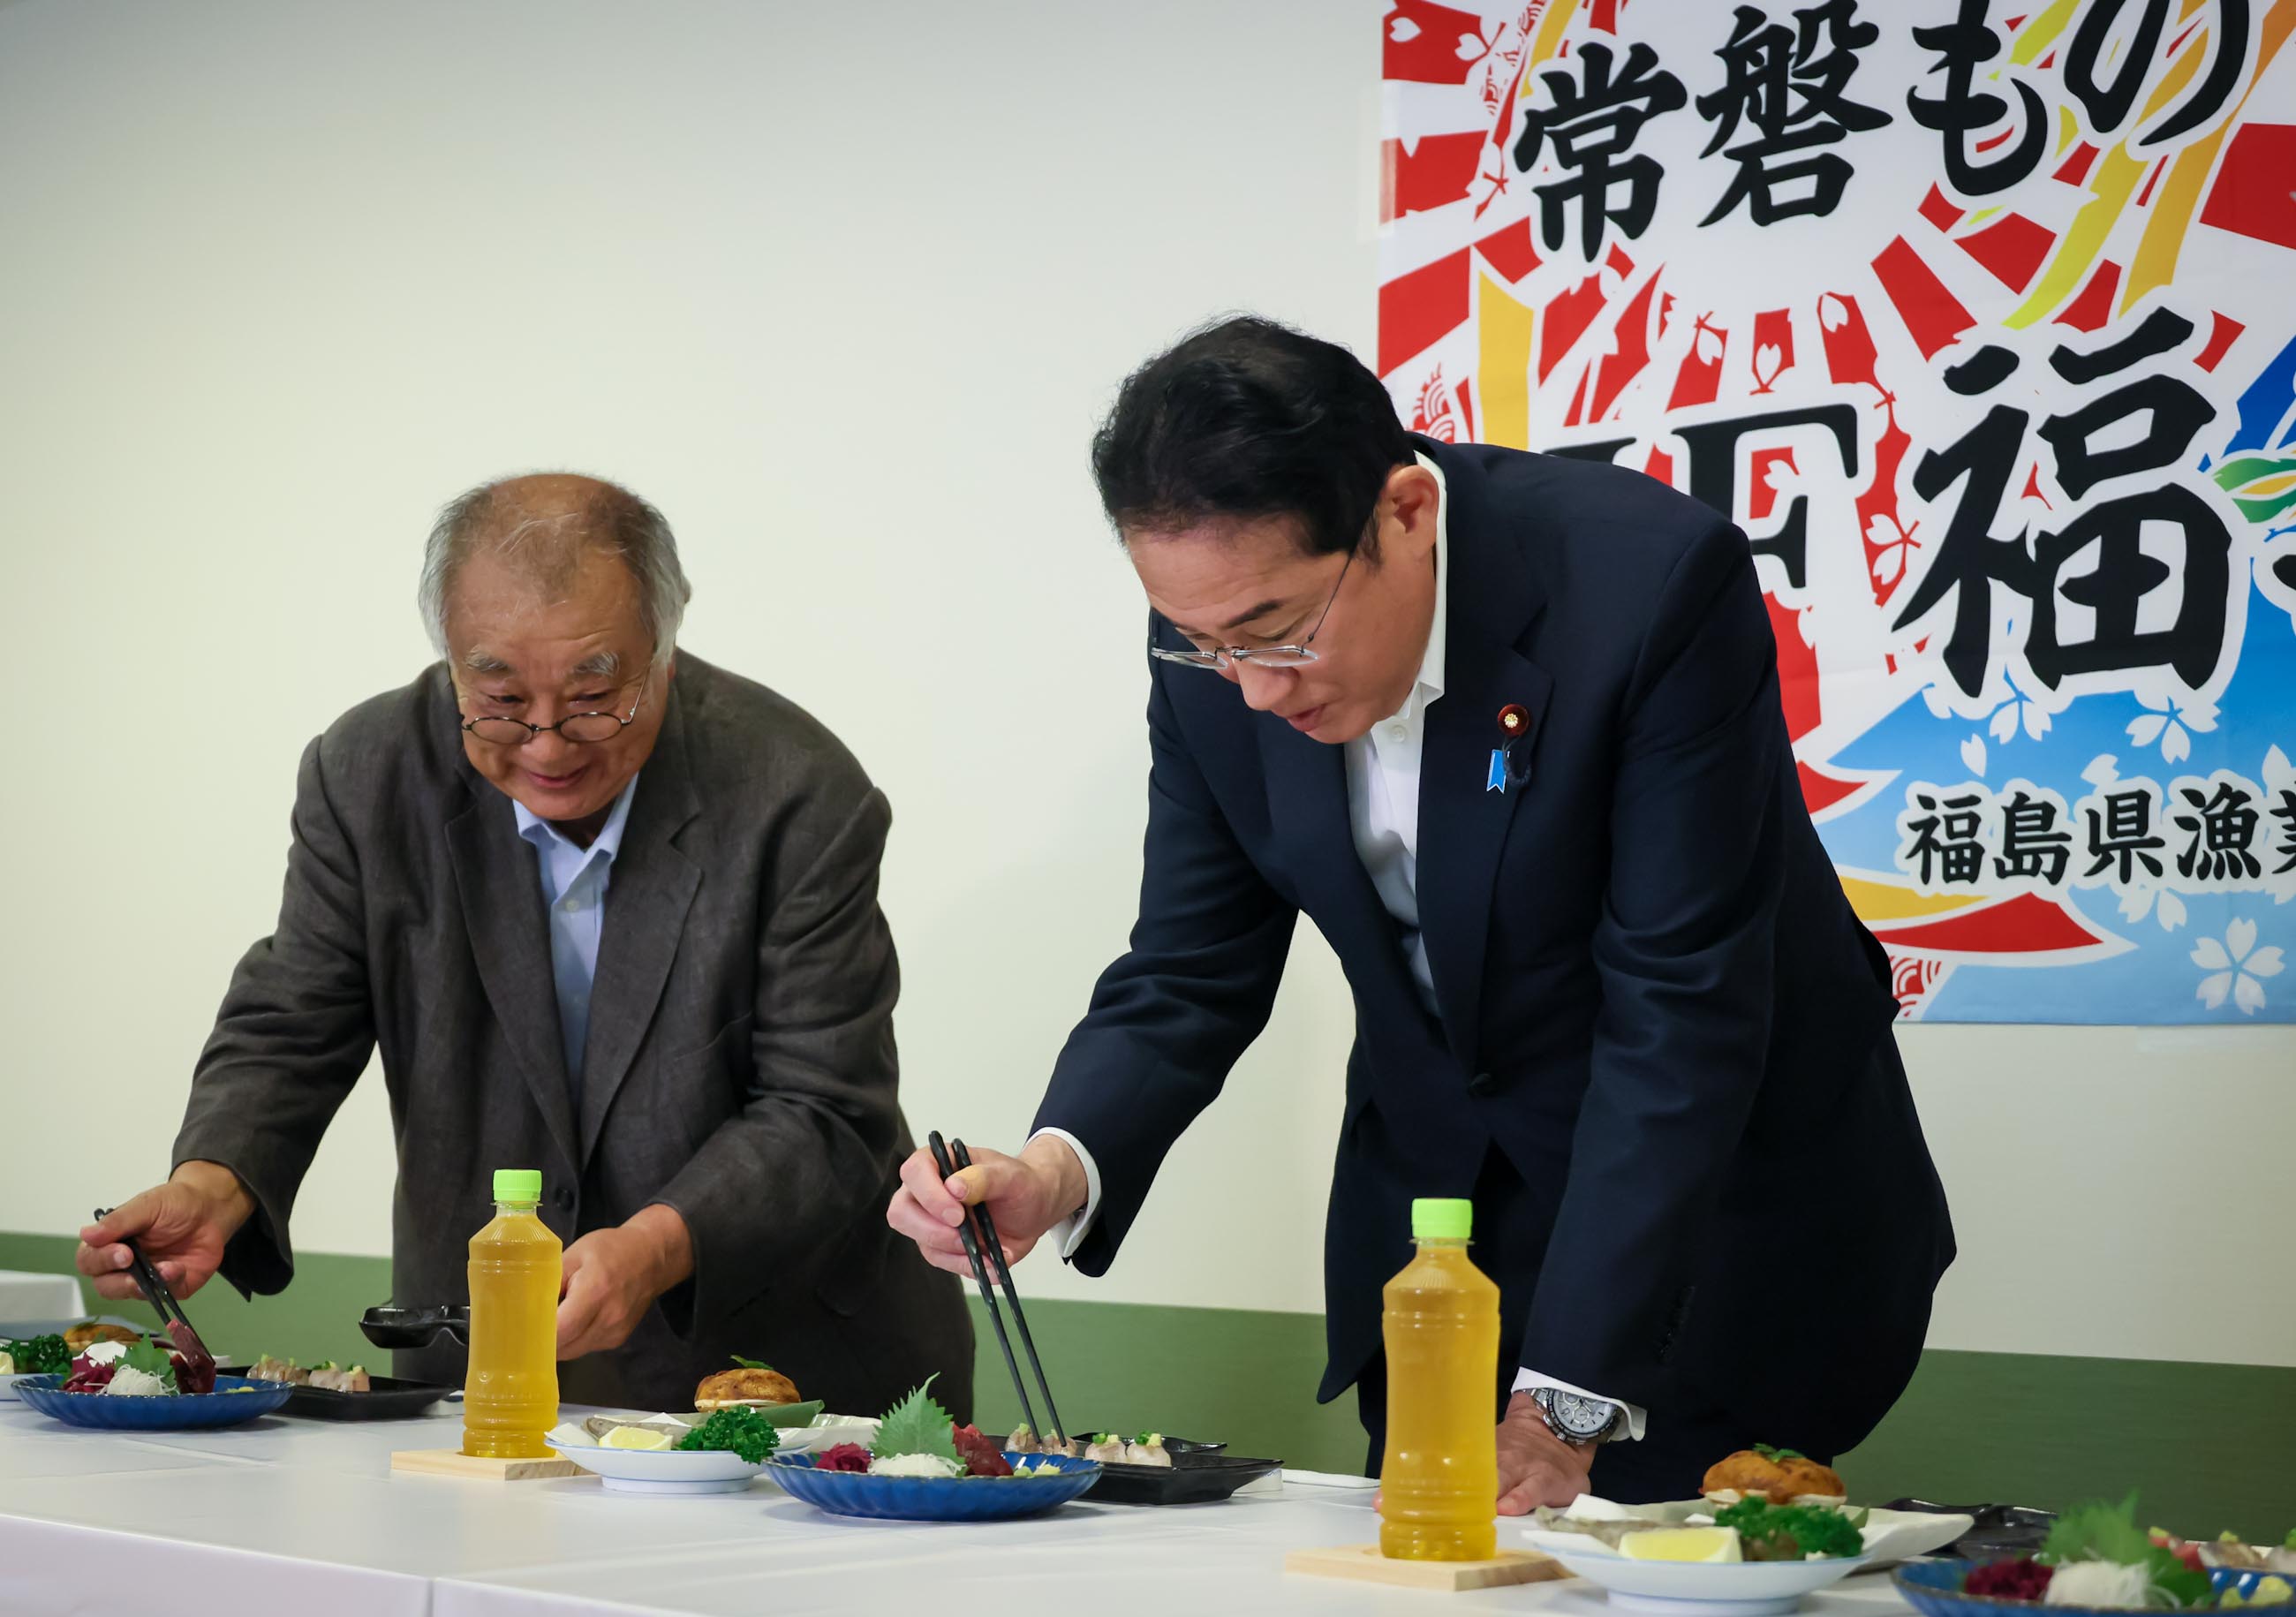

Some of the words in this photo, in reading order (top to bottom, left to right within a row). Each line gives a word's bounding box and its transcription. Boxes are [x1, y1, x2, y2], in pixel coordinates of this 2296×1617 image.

[1513, 0, 2250, 262] 常磐もの
[1543, 306, 2296, 698] F福
